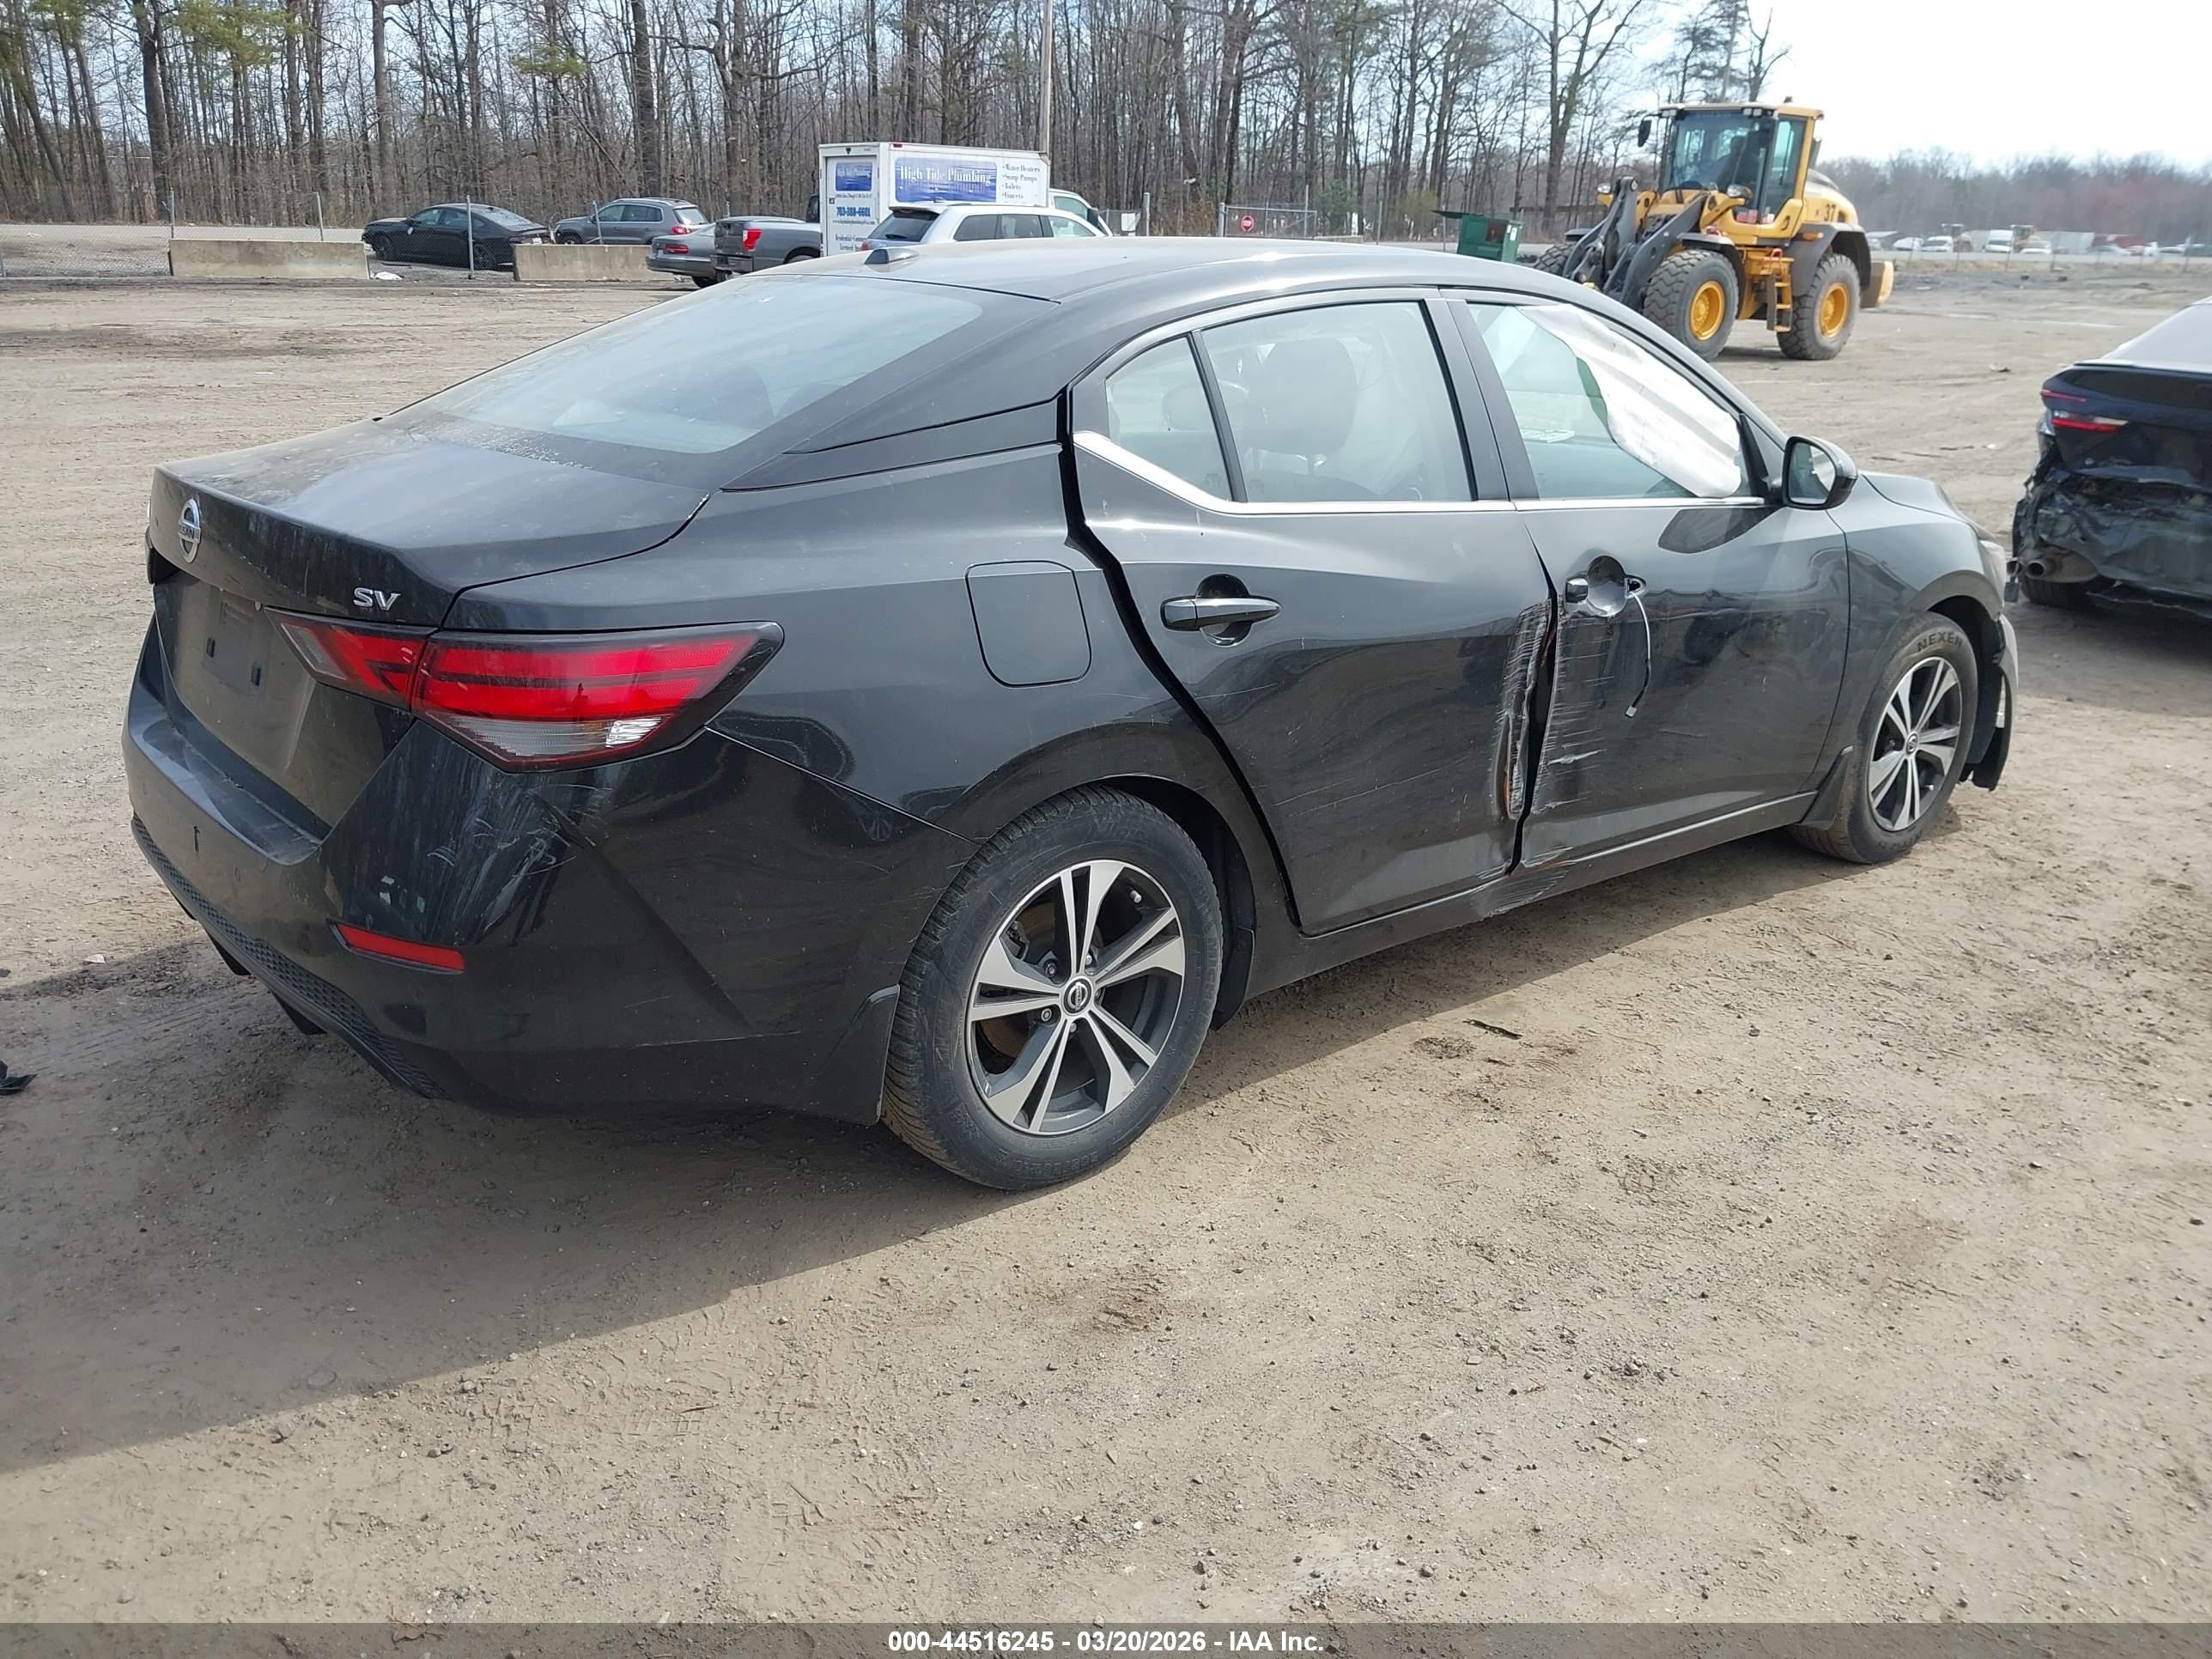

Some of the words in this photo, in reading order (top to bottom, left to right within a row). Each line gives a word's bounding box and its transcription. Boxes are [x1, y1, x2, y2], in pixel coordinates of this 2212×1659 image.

[900, 166, 922, 185] High
[926, 167, 945, 180] Tide
[948, 167, 991, 187] Plumbing
[1823, 204, 1836, 222] 37
[353, 587, 402, 611] SV
[1917, 631, 1964, 652] NEXEN
